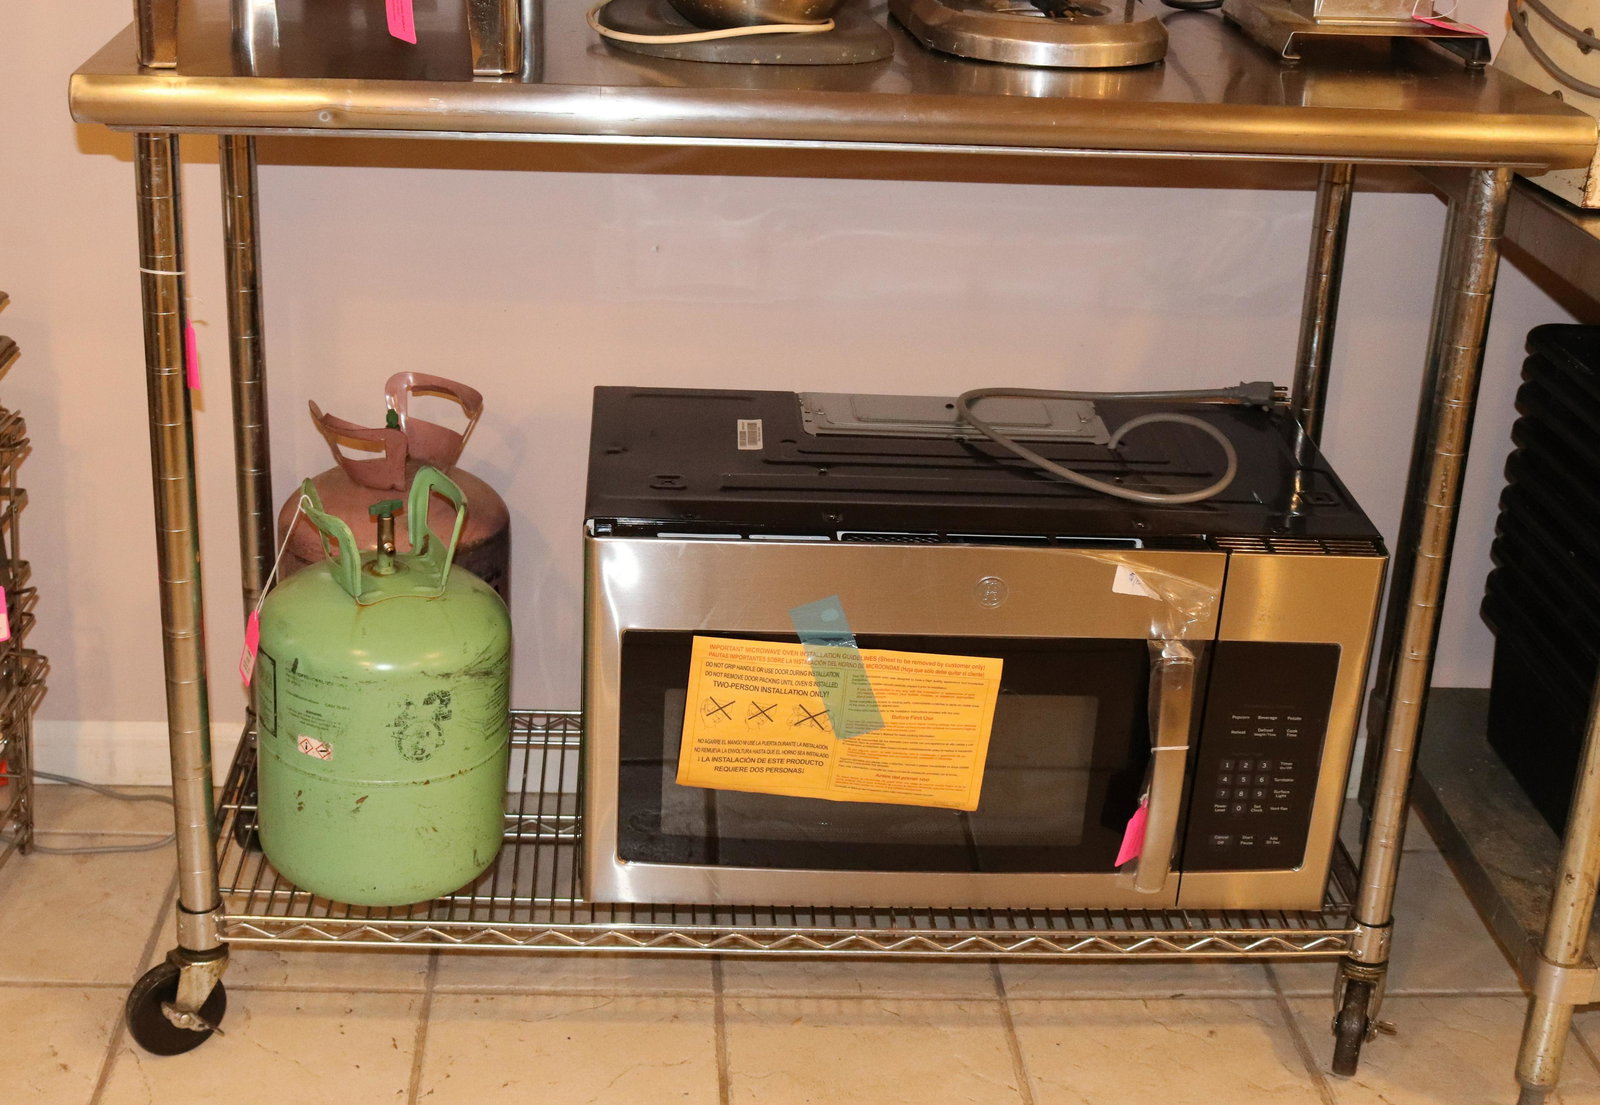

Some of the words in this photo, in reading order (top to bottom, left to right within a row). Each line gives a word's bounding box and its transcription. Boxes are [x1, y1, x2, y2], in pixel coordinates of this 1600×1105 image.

[730, 653, 766, 661] IMPORTANTES
[745, 646, 781, 655] MICROWAVE
[800, 650, 841, 658] INSTALLATION
[713, 680, 759, 691] TWO-PERSON
[761, 687, 809, 696] INSTALLATION
